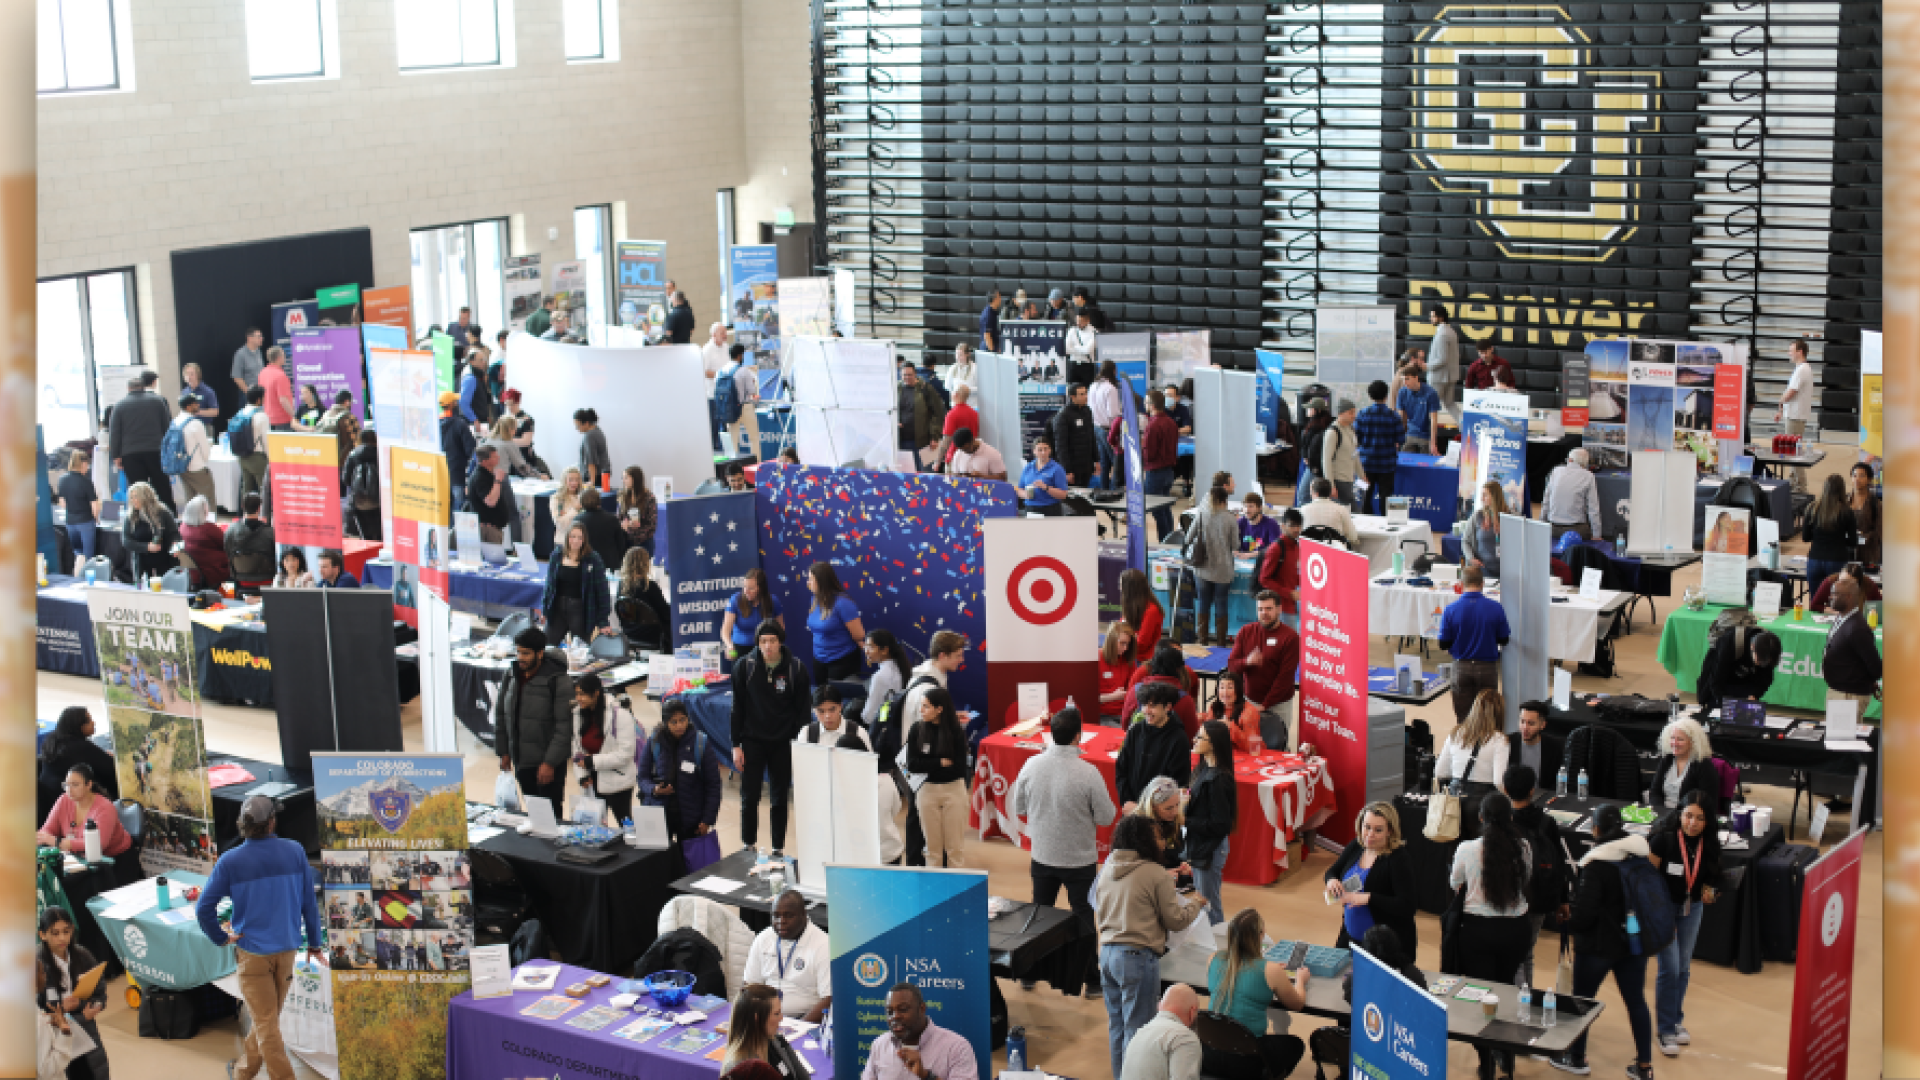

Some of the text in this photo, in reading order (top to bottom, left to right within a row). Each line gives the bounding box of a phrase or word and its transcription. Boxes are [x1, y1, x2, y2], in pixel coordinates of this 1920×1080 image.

[1407, 280, 1655, 346] Denver
[1002, 327, 1063, 338] MEDPACE
[105, 607, 174, 627] JOIN OUR
[1305, 601, 1339, 625] Helping
[106, 625, 178, 653] TEAM
[679, 621, 713, 636] CARE
[1305, 619, 1351, 644] all families
[1305, 635, 1343, 657] discover
[1305, 651, 1345, 676] the joy of
[1304, 669, 1343, 694] everyday
[1303, 694, 1341, 717] Join our
[1303, 709, 1330, 731] Target
[328, 768, 380, 777] DEPARTMENT
[393, 769, 447, 778] CORRECTIONS
[356, 759, 414, 770] COLORADO
[347, 838, 408, 849] ELEVATING
[905, 957, 941, 973] NSA
[905, 973, 965, 990] Careers
[1393, 1019, 1416, 1050] NSA
[501, 1040, 563, 1068] COLORADO
